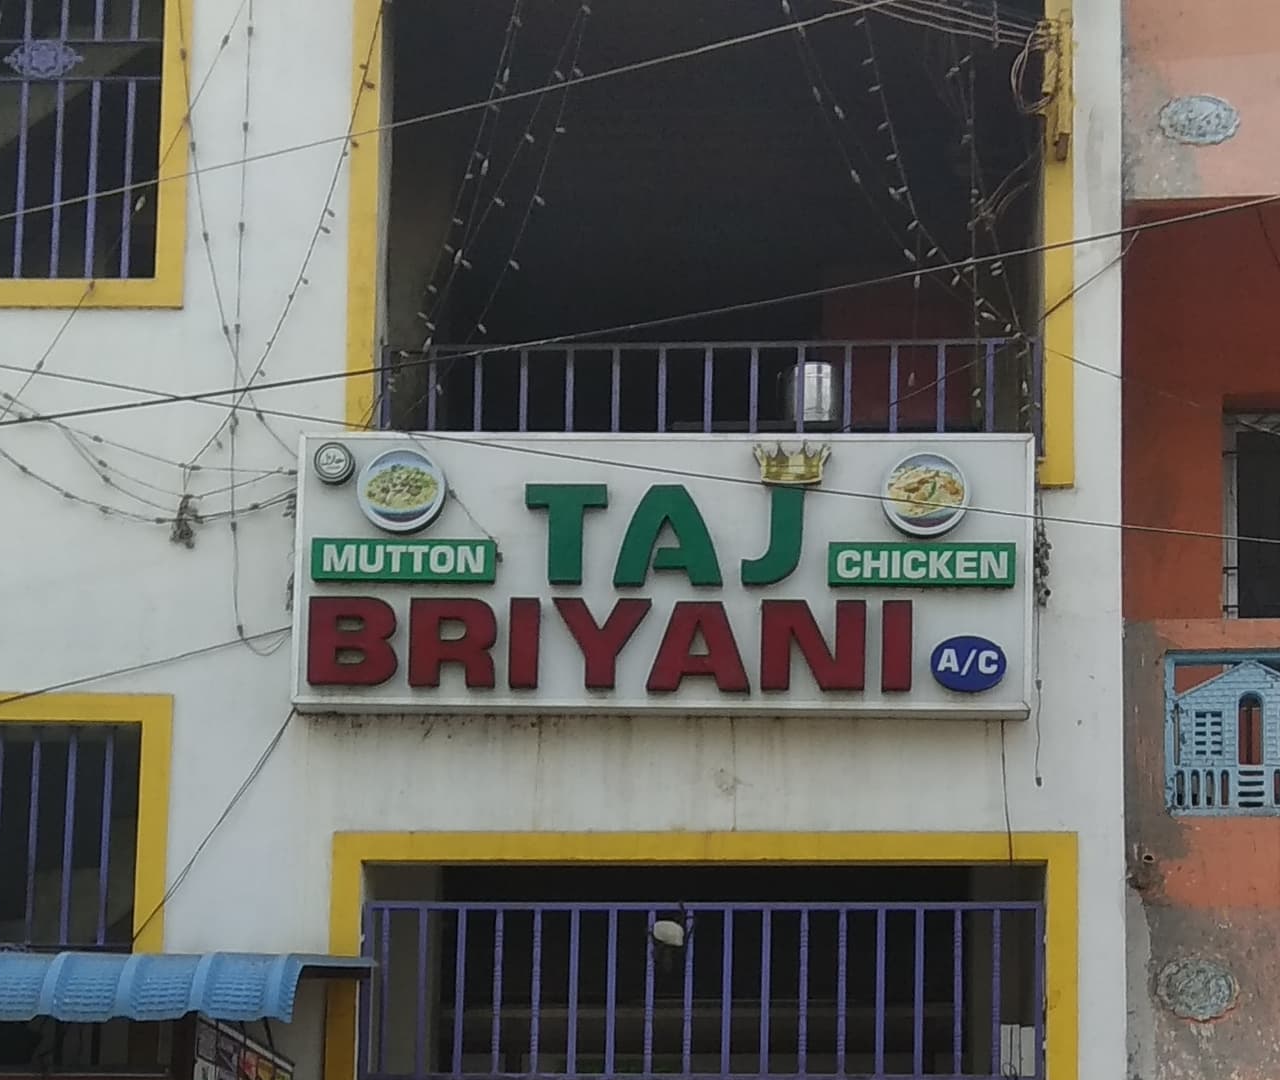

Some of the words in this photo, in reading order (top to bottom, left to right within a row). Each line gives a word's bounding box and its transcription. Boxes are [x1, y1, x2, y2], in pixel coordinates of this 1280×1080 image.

[525, 484, 806, 586] TAJ
[322, 544, 487, 574] MUTTON
[836, 549, 1009, 580] CHICKEN
[307, 596, 913, 694] BRIYANI
[937, 648, 999, 676] A/C
